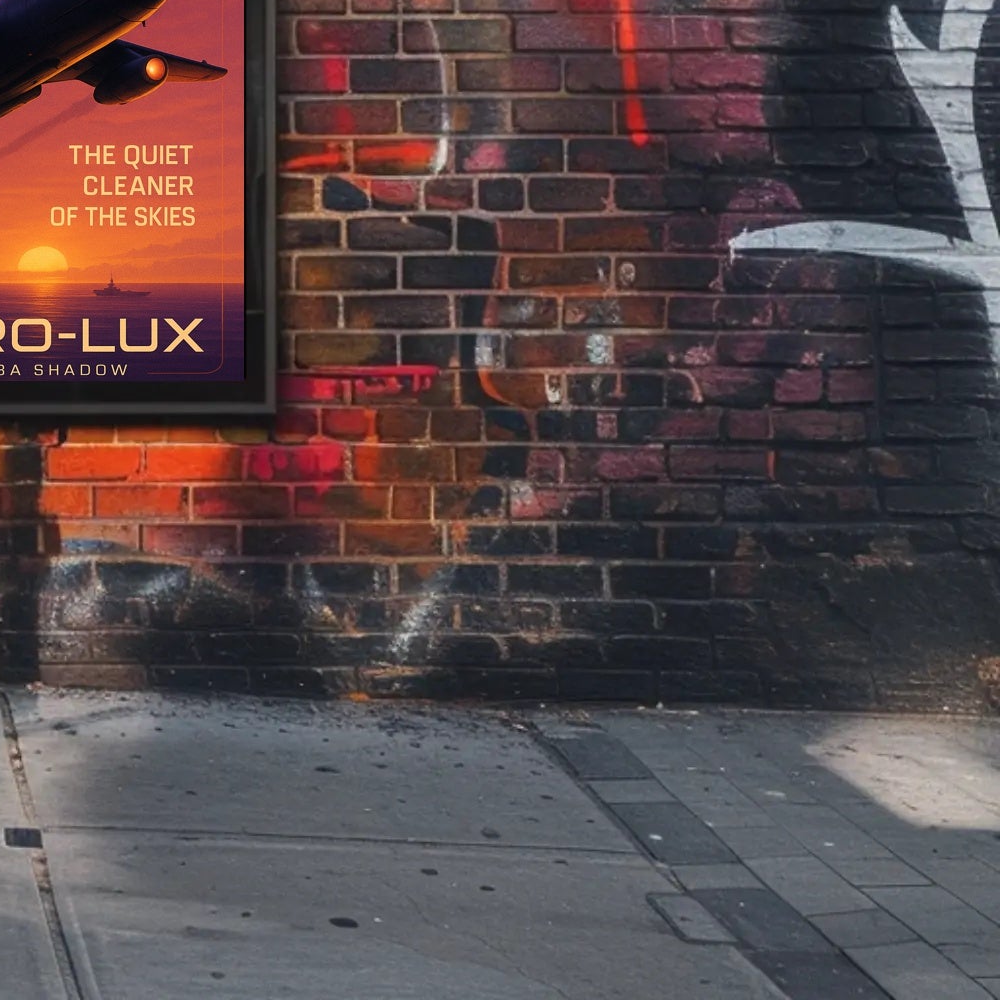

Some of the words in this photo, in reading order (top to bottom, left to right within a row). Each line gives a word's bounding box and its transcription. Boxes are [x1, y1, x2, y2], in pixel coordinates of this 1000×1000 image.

[68, 144, 116, 165] THE
[124, 144, 194, 170] QUIET
[83, 175, 194, 196] CLEANER
[50, 206, 78, 227] OF
[84, 206, 127, 227] THE
[134, 206, 196, 227] SKIES
[34, 363, 129, 377] SHADOW
